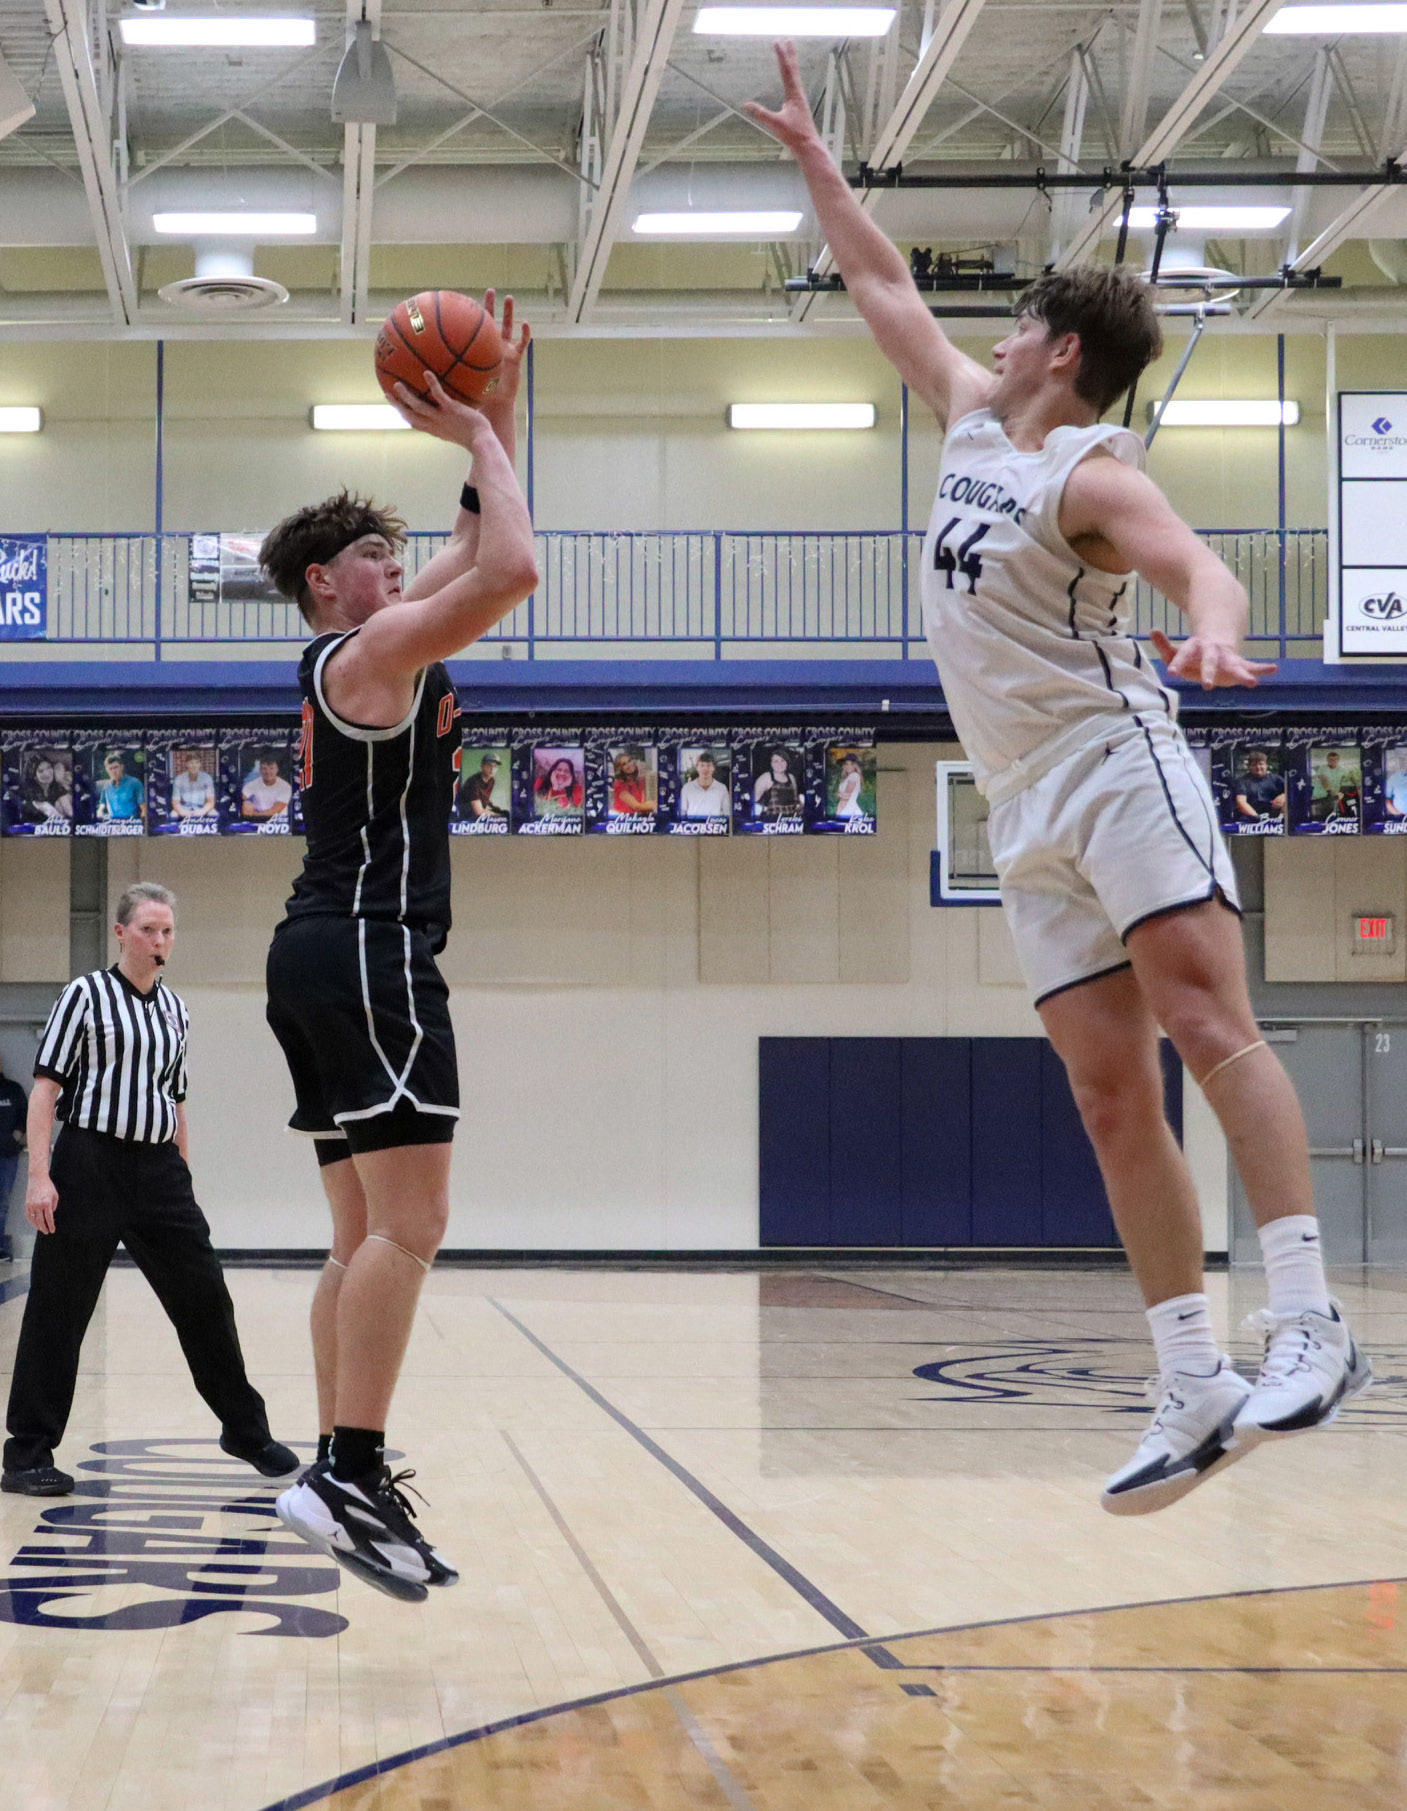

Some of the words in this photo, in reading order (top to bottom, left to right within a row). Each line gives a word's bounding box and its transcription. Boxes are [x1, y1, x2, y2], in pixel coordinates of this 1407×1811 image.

[933, 516, 991, 597] 44
[1364, 592, 1403, 619] CVA
[34, 824, 71, 836] BAULD
[74, 824, 144, 836] SCHMIDTBERGER
[179, 823, 218, 834] DUBAS
[257, 823, 290, 834] NOYD
[451, 823, 508, 834] LINDBURG
[517, 823, 582, 834] ACKERMAN
[606, 822, 656, 833] QUILHOT
[669, 823, 728, 834] JACOBSEN
[762, 823, 804, 834] SCHRAM
[844, 823, 875, 834] KROL
[1238, 823, 1284, 834] WILLIAMS
[1322, 823, 1359, 834] JONES
[1360, 917, 1387, 938] EXIT
[1374, 1033, 1390, 1053] 23
